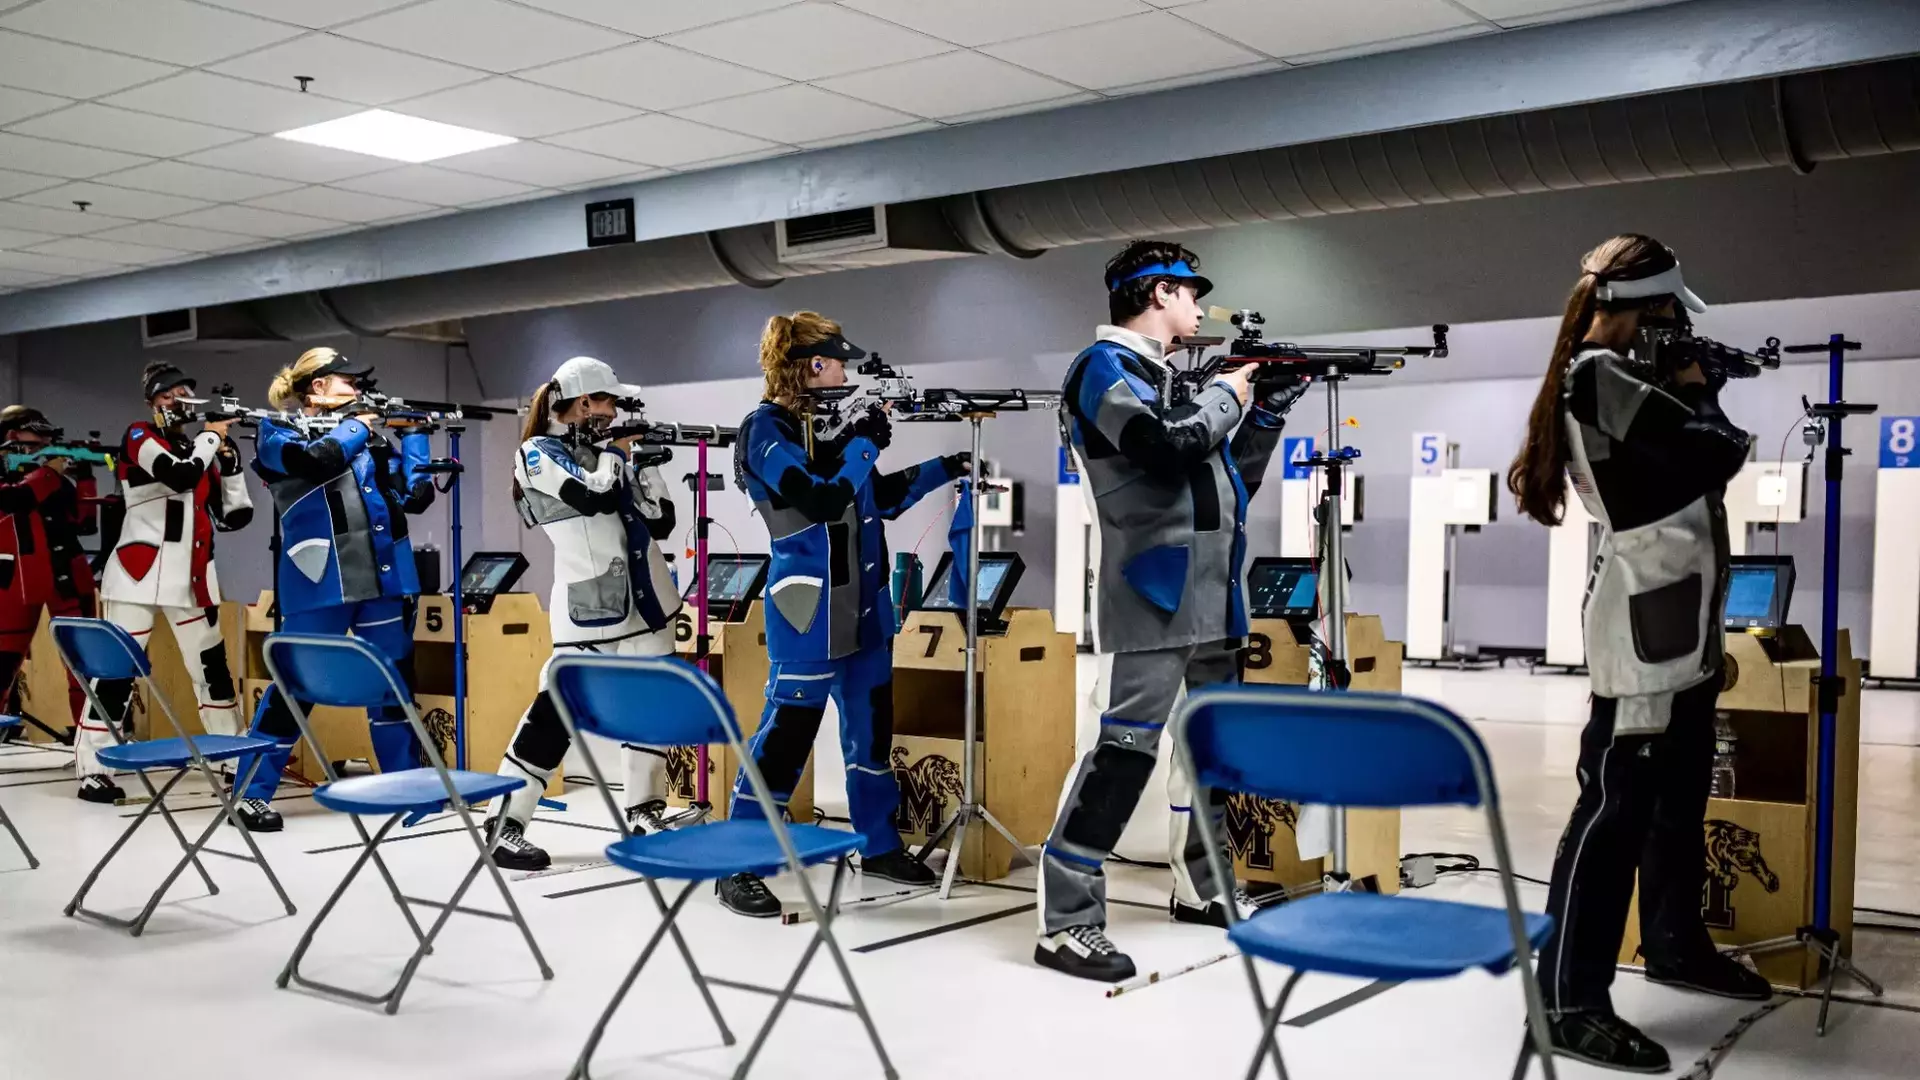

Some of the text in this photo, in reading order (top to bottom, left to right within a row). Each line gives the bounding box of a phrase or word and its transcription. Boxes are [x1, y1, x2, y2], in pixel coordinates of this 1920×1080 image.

[1289, 439, 1309, 467] 4
[1421, 436, 1438, 465] 5
[1889, 419, 1915, 454] 8
[426, 606, 443, 632] 5
[676, 613, 692, 642] 6
[919, 625, 943, 658] 7
[1245, 633, 1272, 669] 8
[895, 768, 942, 837] M
[1226, 796, 1274, 871] M
